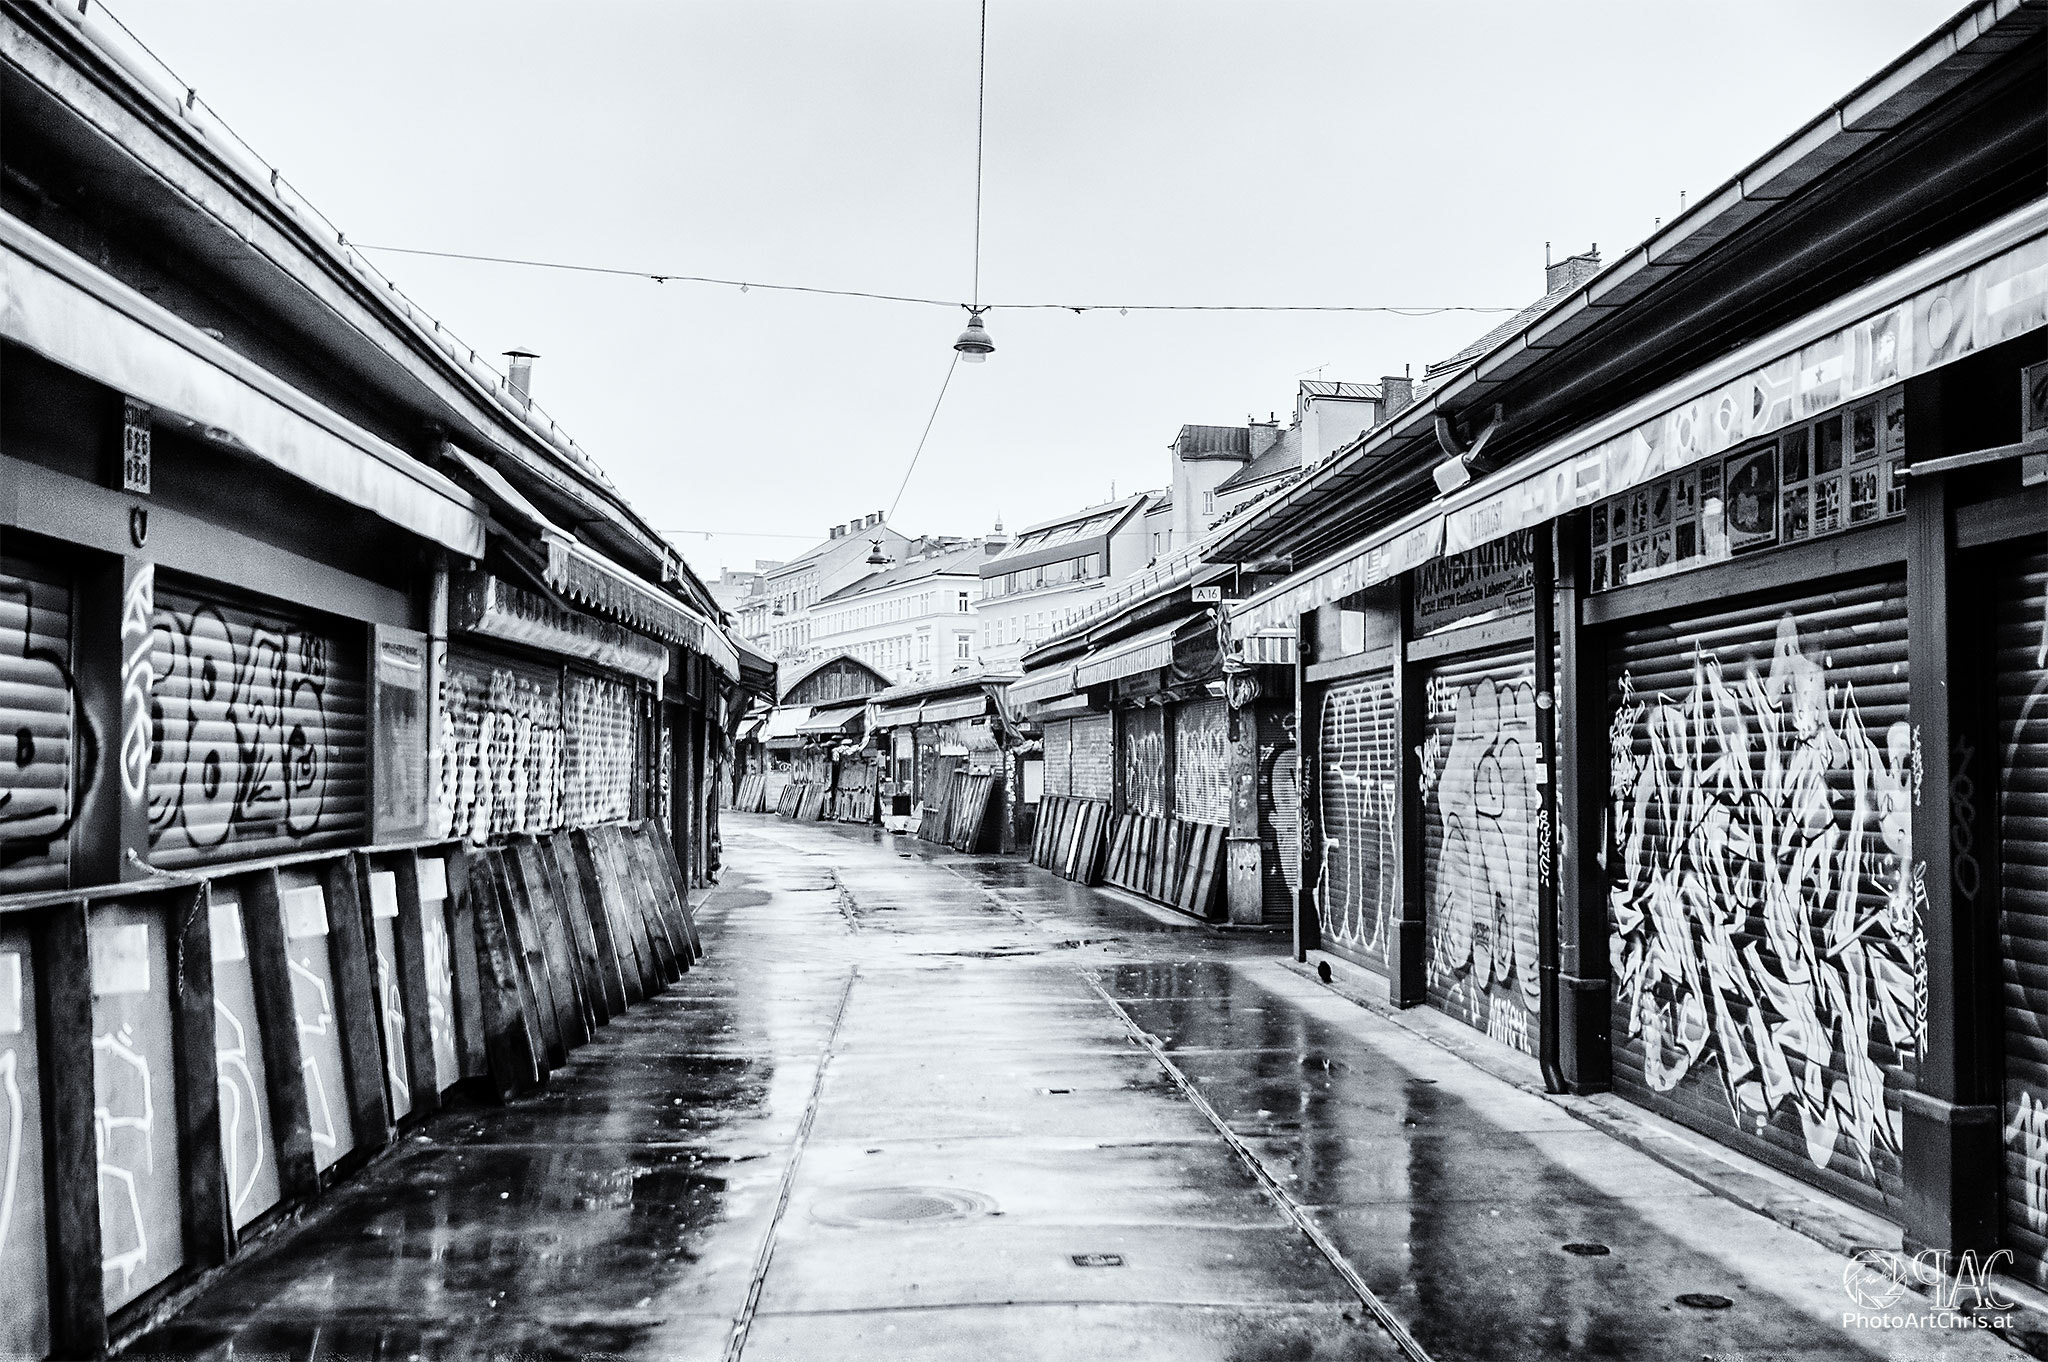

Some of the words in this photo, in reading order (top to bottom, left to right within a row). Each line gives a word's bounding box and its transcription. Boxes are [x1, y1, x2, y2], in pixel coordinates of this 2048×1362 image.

[126, 428, 149, 456] 625
[1196, 590, 1206, 600] A
[1208, 588, 1218, 600] 16
